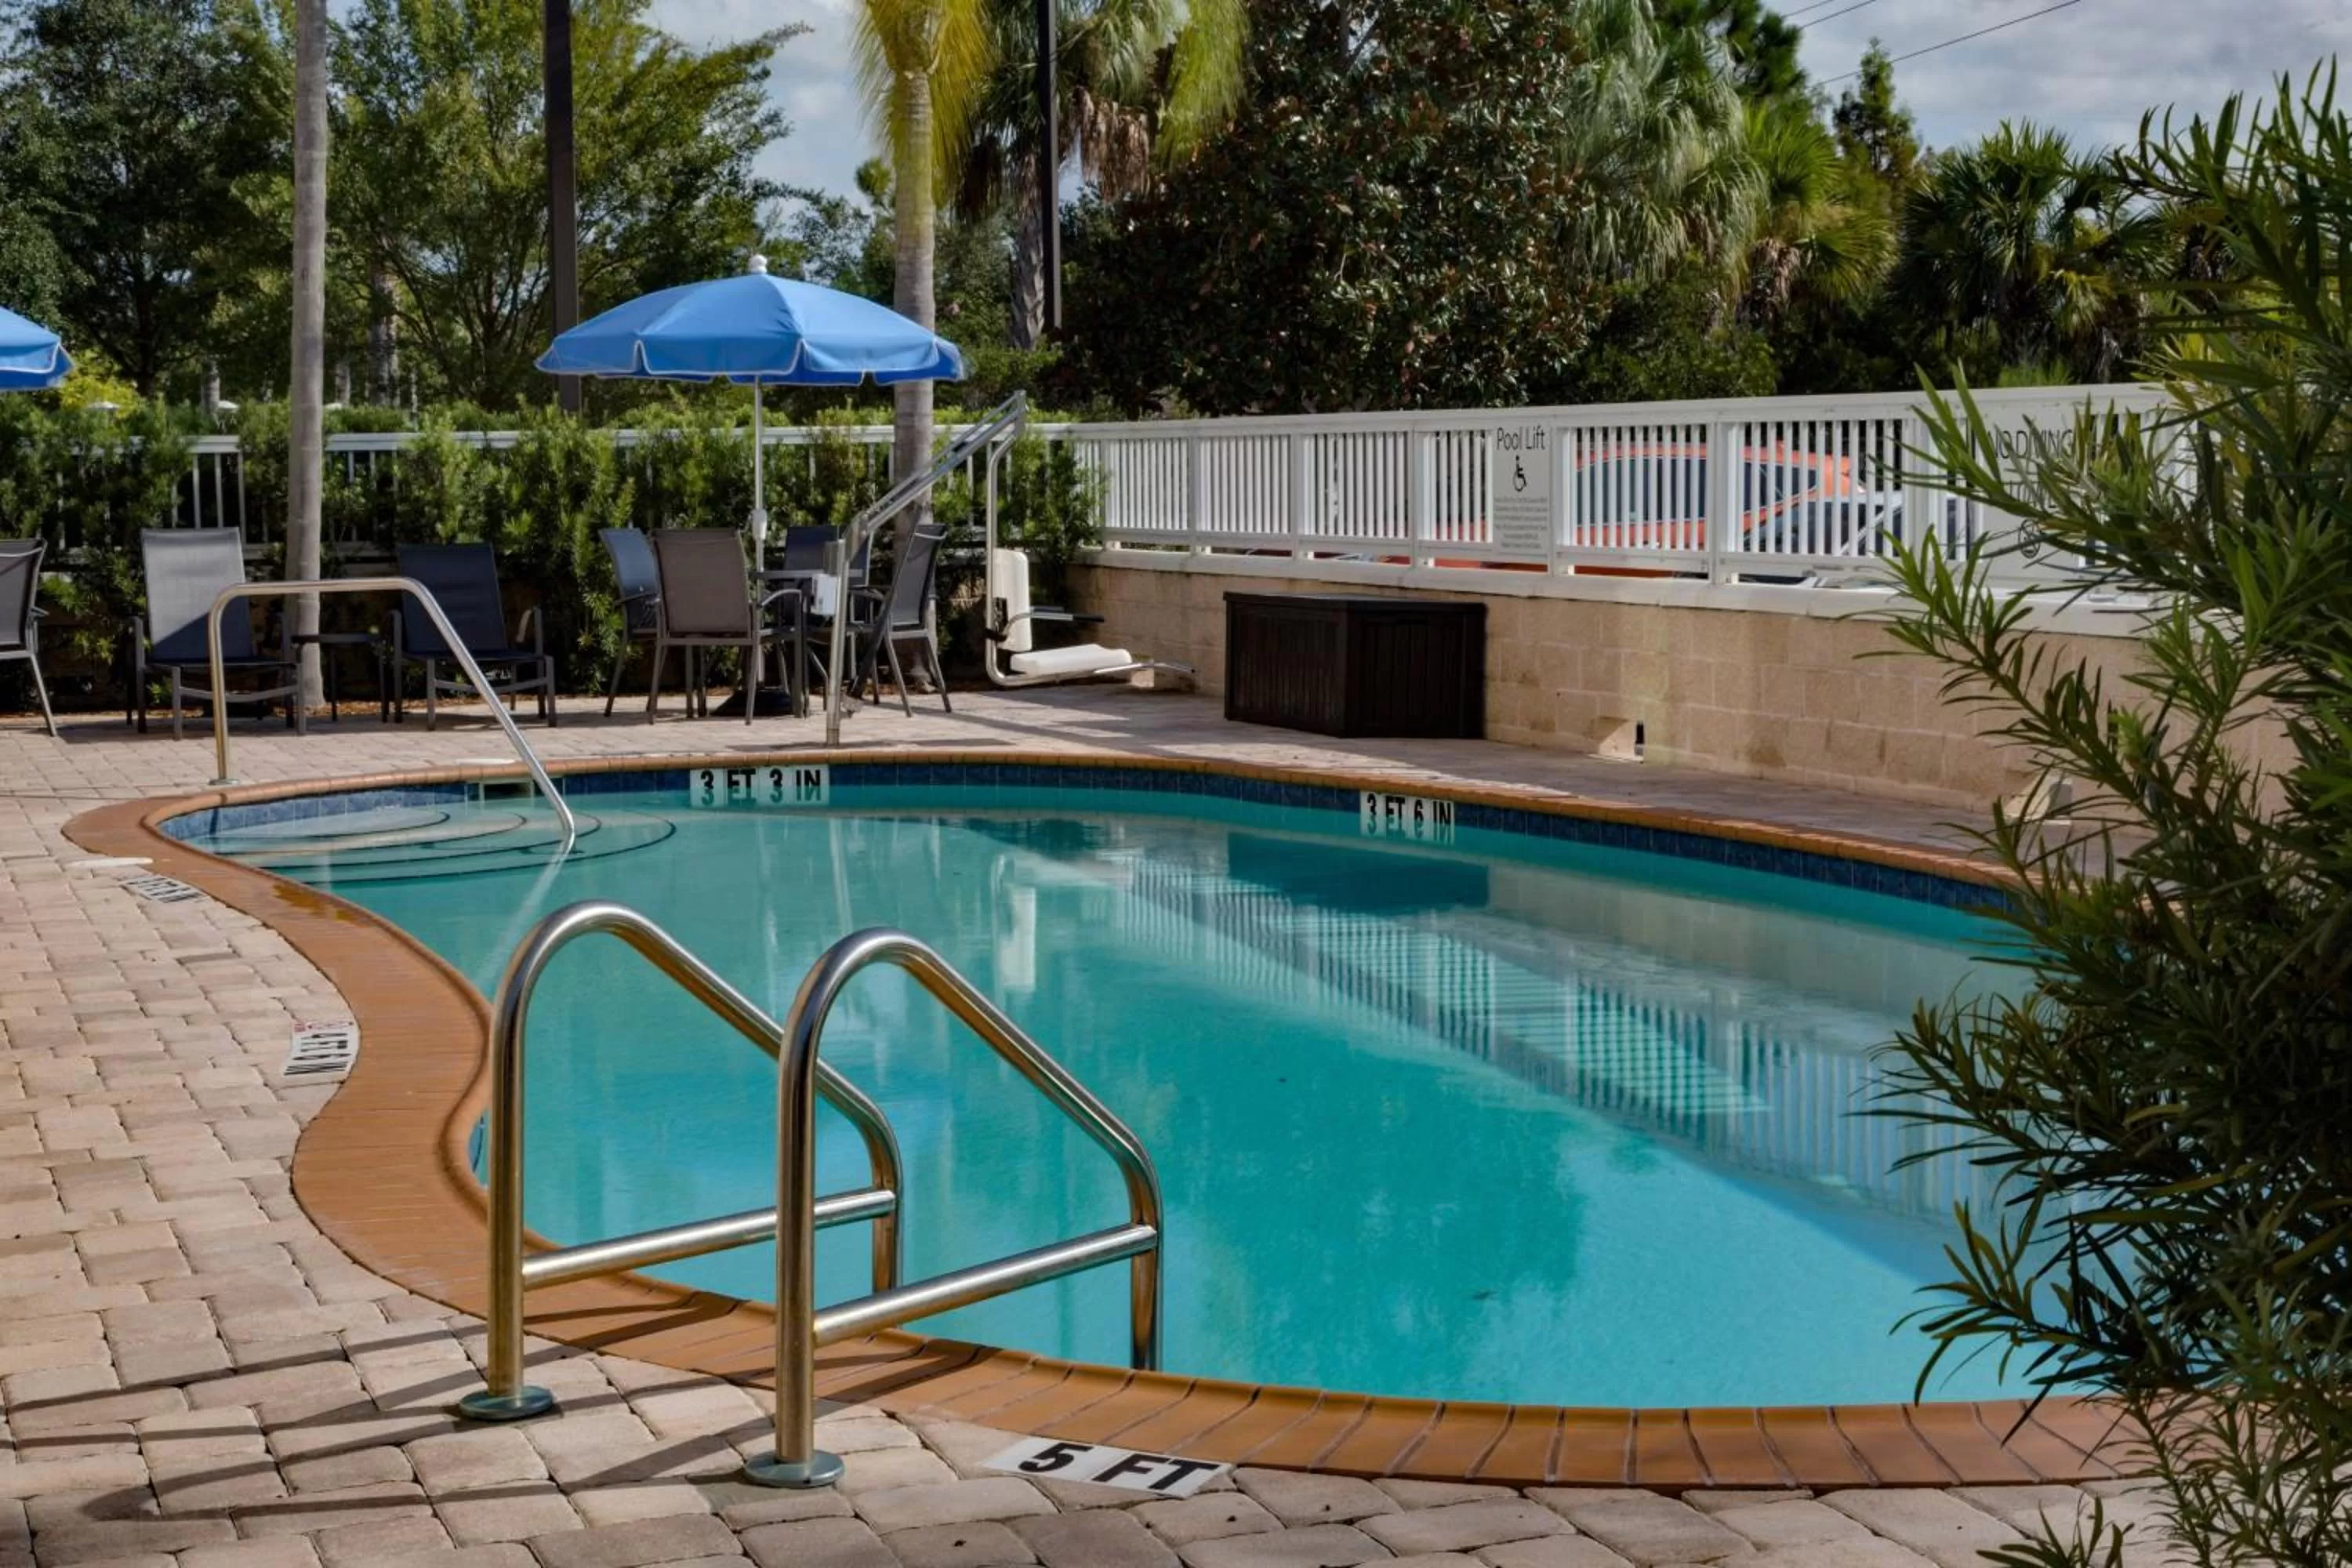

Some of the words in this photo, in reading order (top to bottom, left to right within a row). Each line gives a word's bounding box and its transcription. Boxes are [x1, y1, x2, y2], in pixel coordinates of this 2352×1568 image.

[1496, 426, 1523, 451] Pool
[1526, 424, 1546, 450] Lift
[2016, 429, 2074, 459] DNG
[699, 769, 715, 790] 3
[727, 768, 757, 789] FT
[769, 769, 783, 789] 3
[795, 769, 822, 789] IN
[1367, 793, 1377, 818] 3
[1385, 795, 1406, 822] FT
[1414, 799, 1425, 824] 6
[1432, 800, 1451, 826] IN
[1018, 1442, 1095, 1473] 5
[1091, 1453, 1221, 1490] FT
